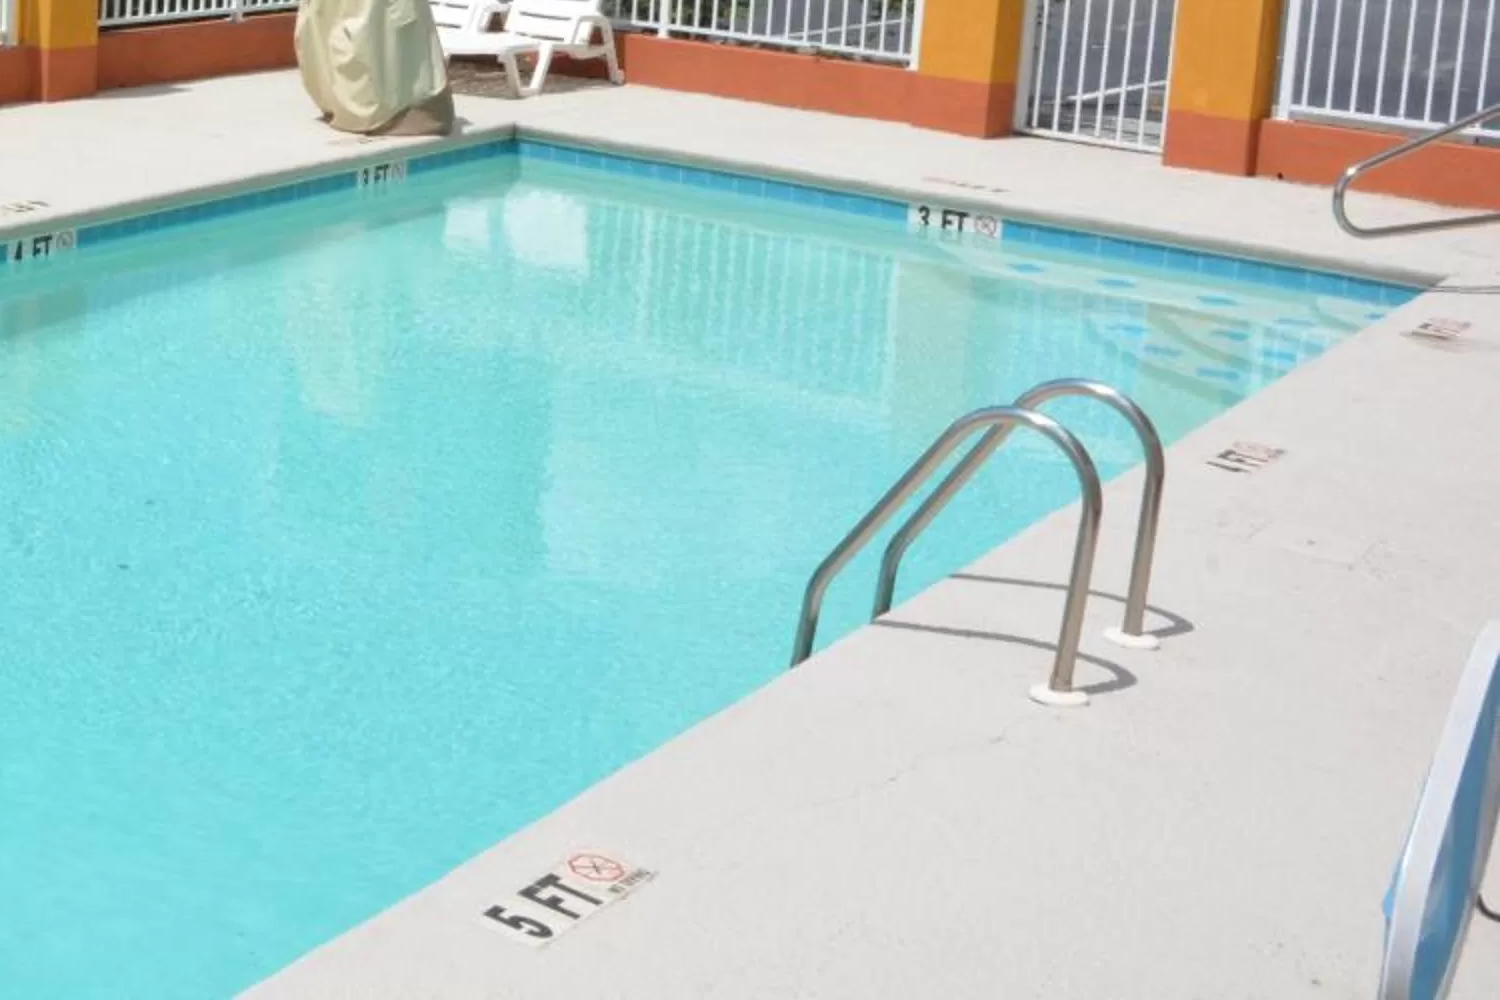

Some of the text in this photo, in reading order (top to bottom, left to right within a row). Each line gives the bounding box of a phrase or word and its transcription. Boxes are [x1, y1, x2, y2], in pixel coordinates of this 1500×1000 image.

[918, 205, 970, 233] 3 FT
[32, 234, 53, 258] FT
[516, 872, 604, 921] FT
[483, 904, 554, 940] 5
